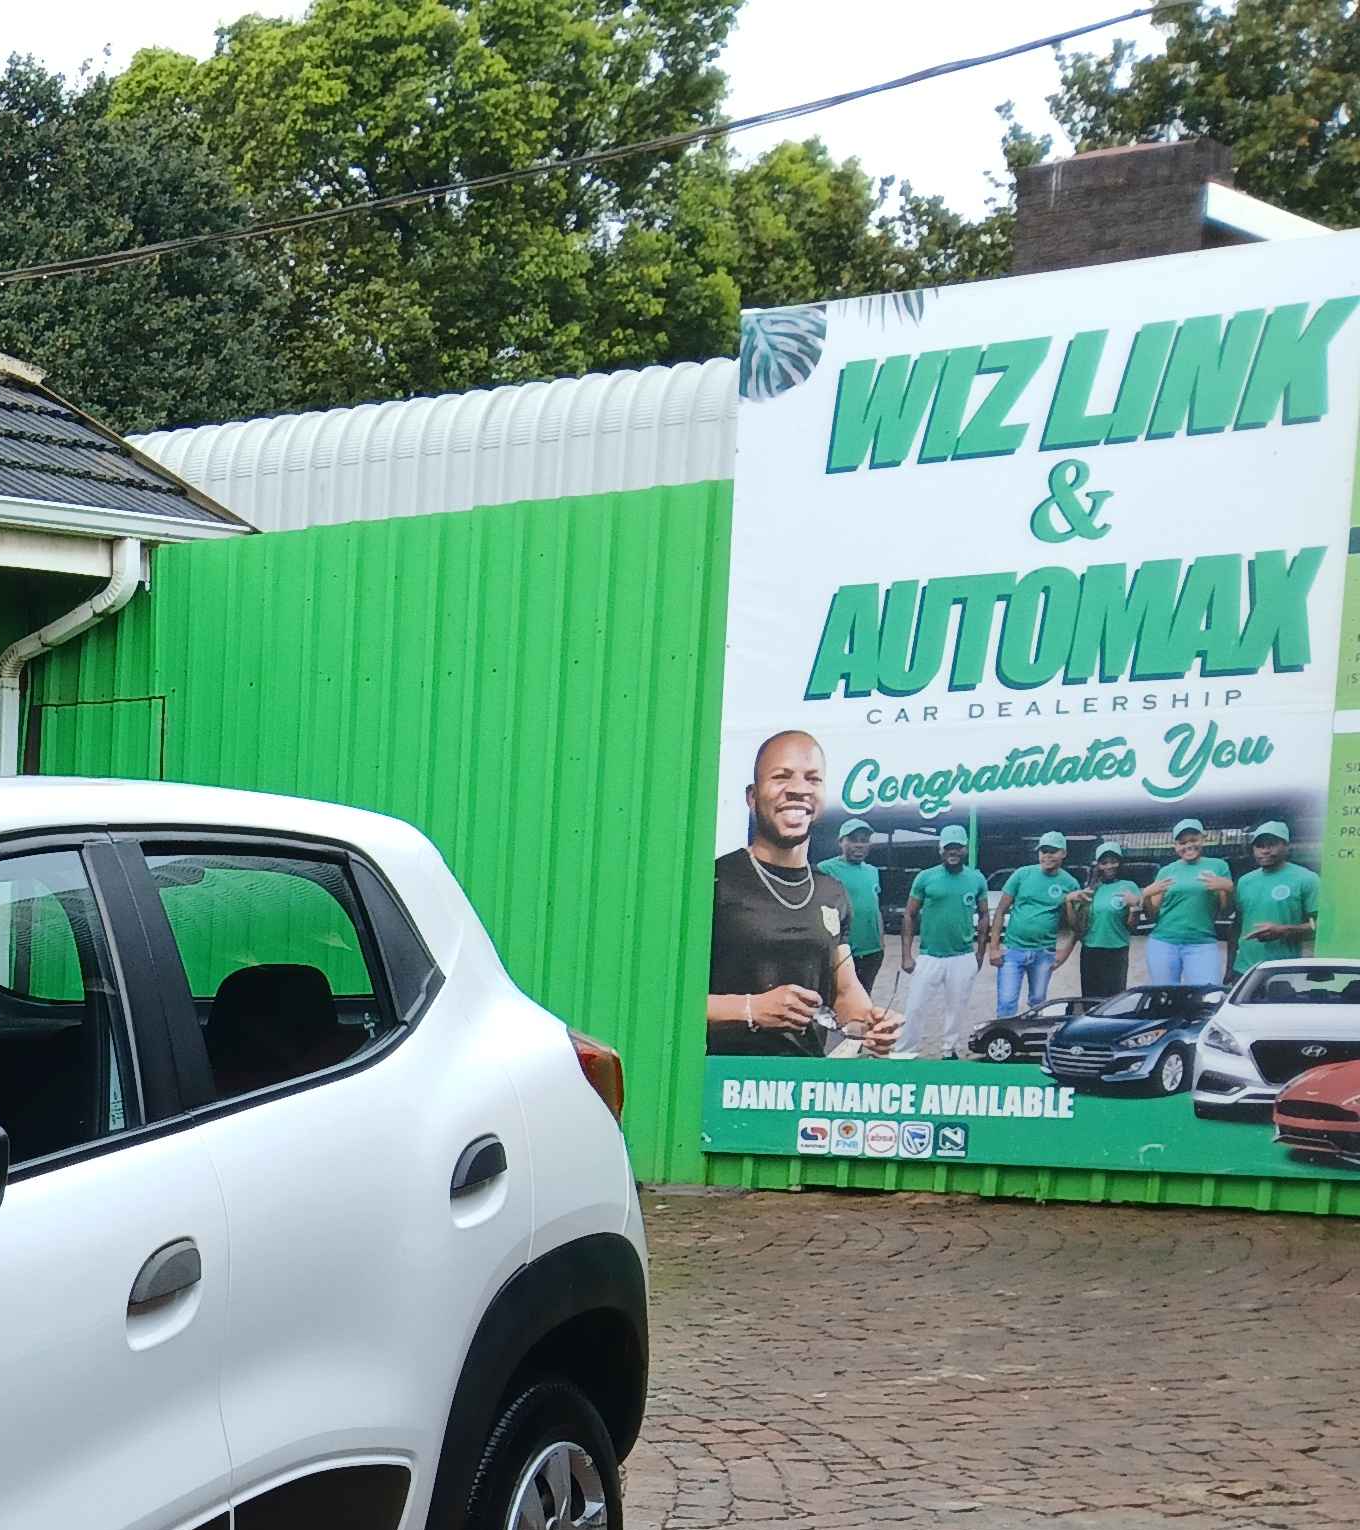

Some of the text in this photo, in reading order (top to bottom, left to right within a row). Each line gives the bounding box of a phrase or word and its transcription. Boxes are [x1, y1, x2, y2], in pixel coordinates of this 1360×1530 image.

[825, 295, 1358, 475] WIZ LINK
[1029, 458, 1115, 544] &
[803, 545, 1328, 702] AUTOMAX
[866, 689, 1244, 725] CAR DEALERSHIP
[841, 720, 1274, 819] Congratulates You
[722, 1079, 1075, 1119] BANK FINANCE AVAILABLE
